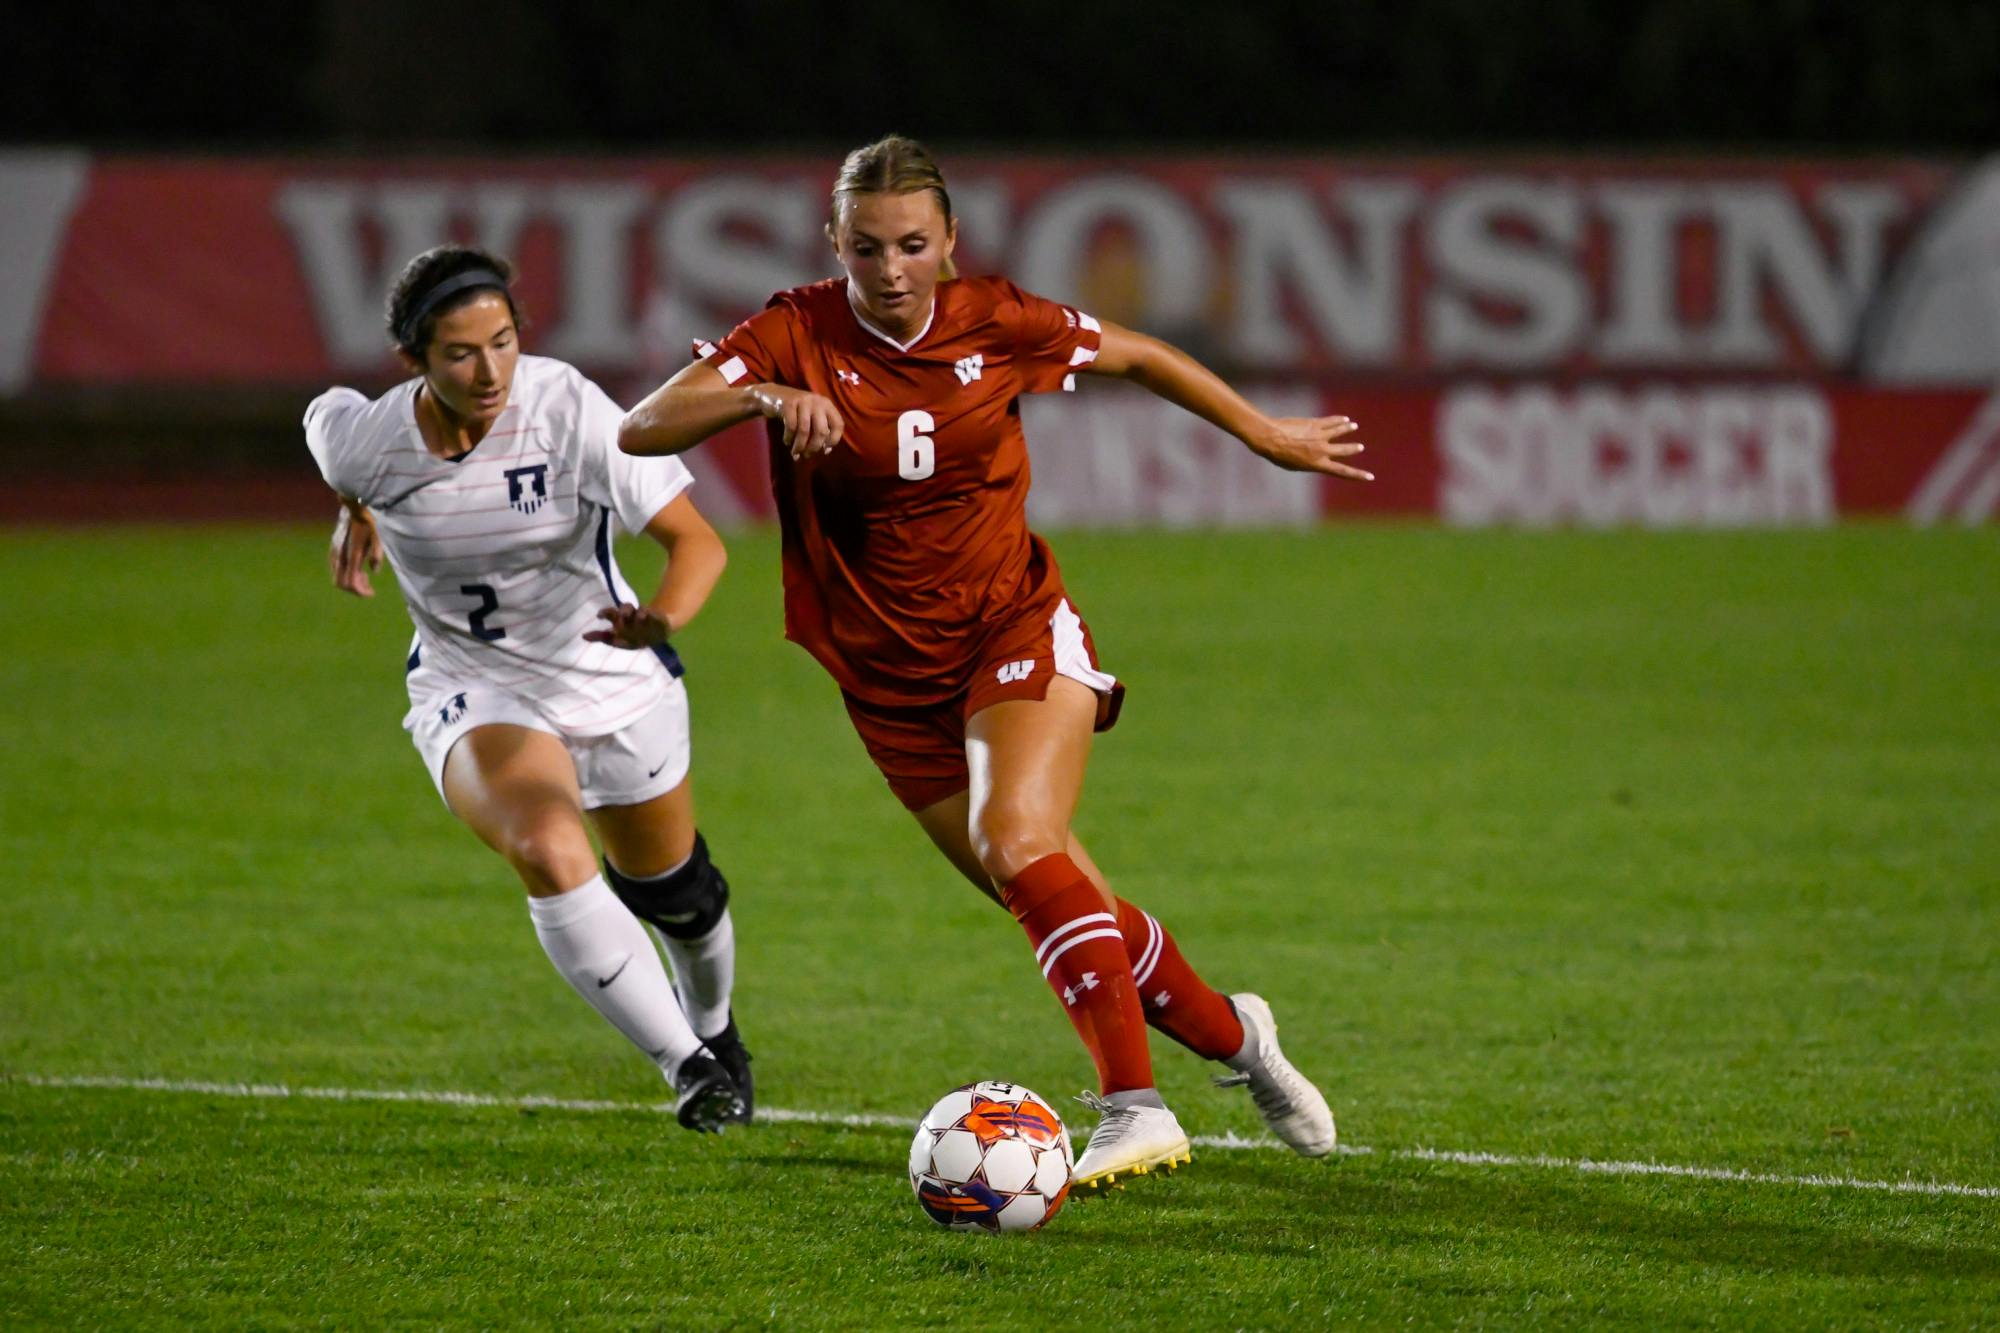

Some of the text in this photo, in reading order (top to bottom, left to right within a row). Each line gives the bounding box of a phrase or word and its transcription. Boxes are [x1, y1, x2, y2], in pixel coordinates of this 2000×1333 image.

[277, 173, 1905, 369] WISONSIN
[897, 409, 935, 481] 6
[1437, 386, 1837, 525] SOCCER
[460, 584, 506, 641] 2
